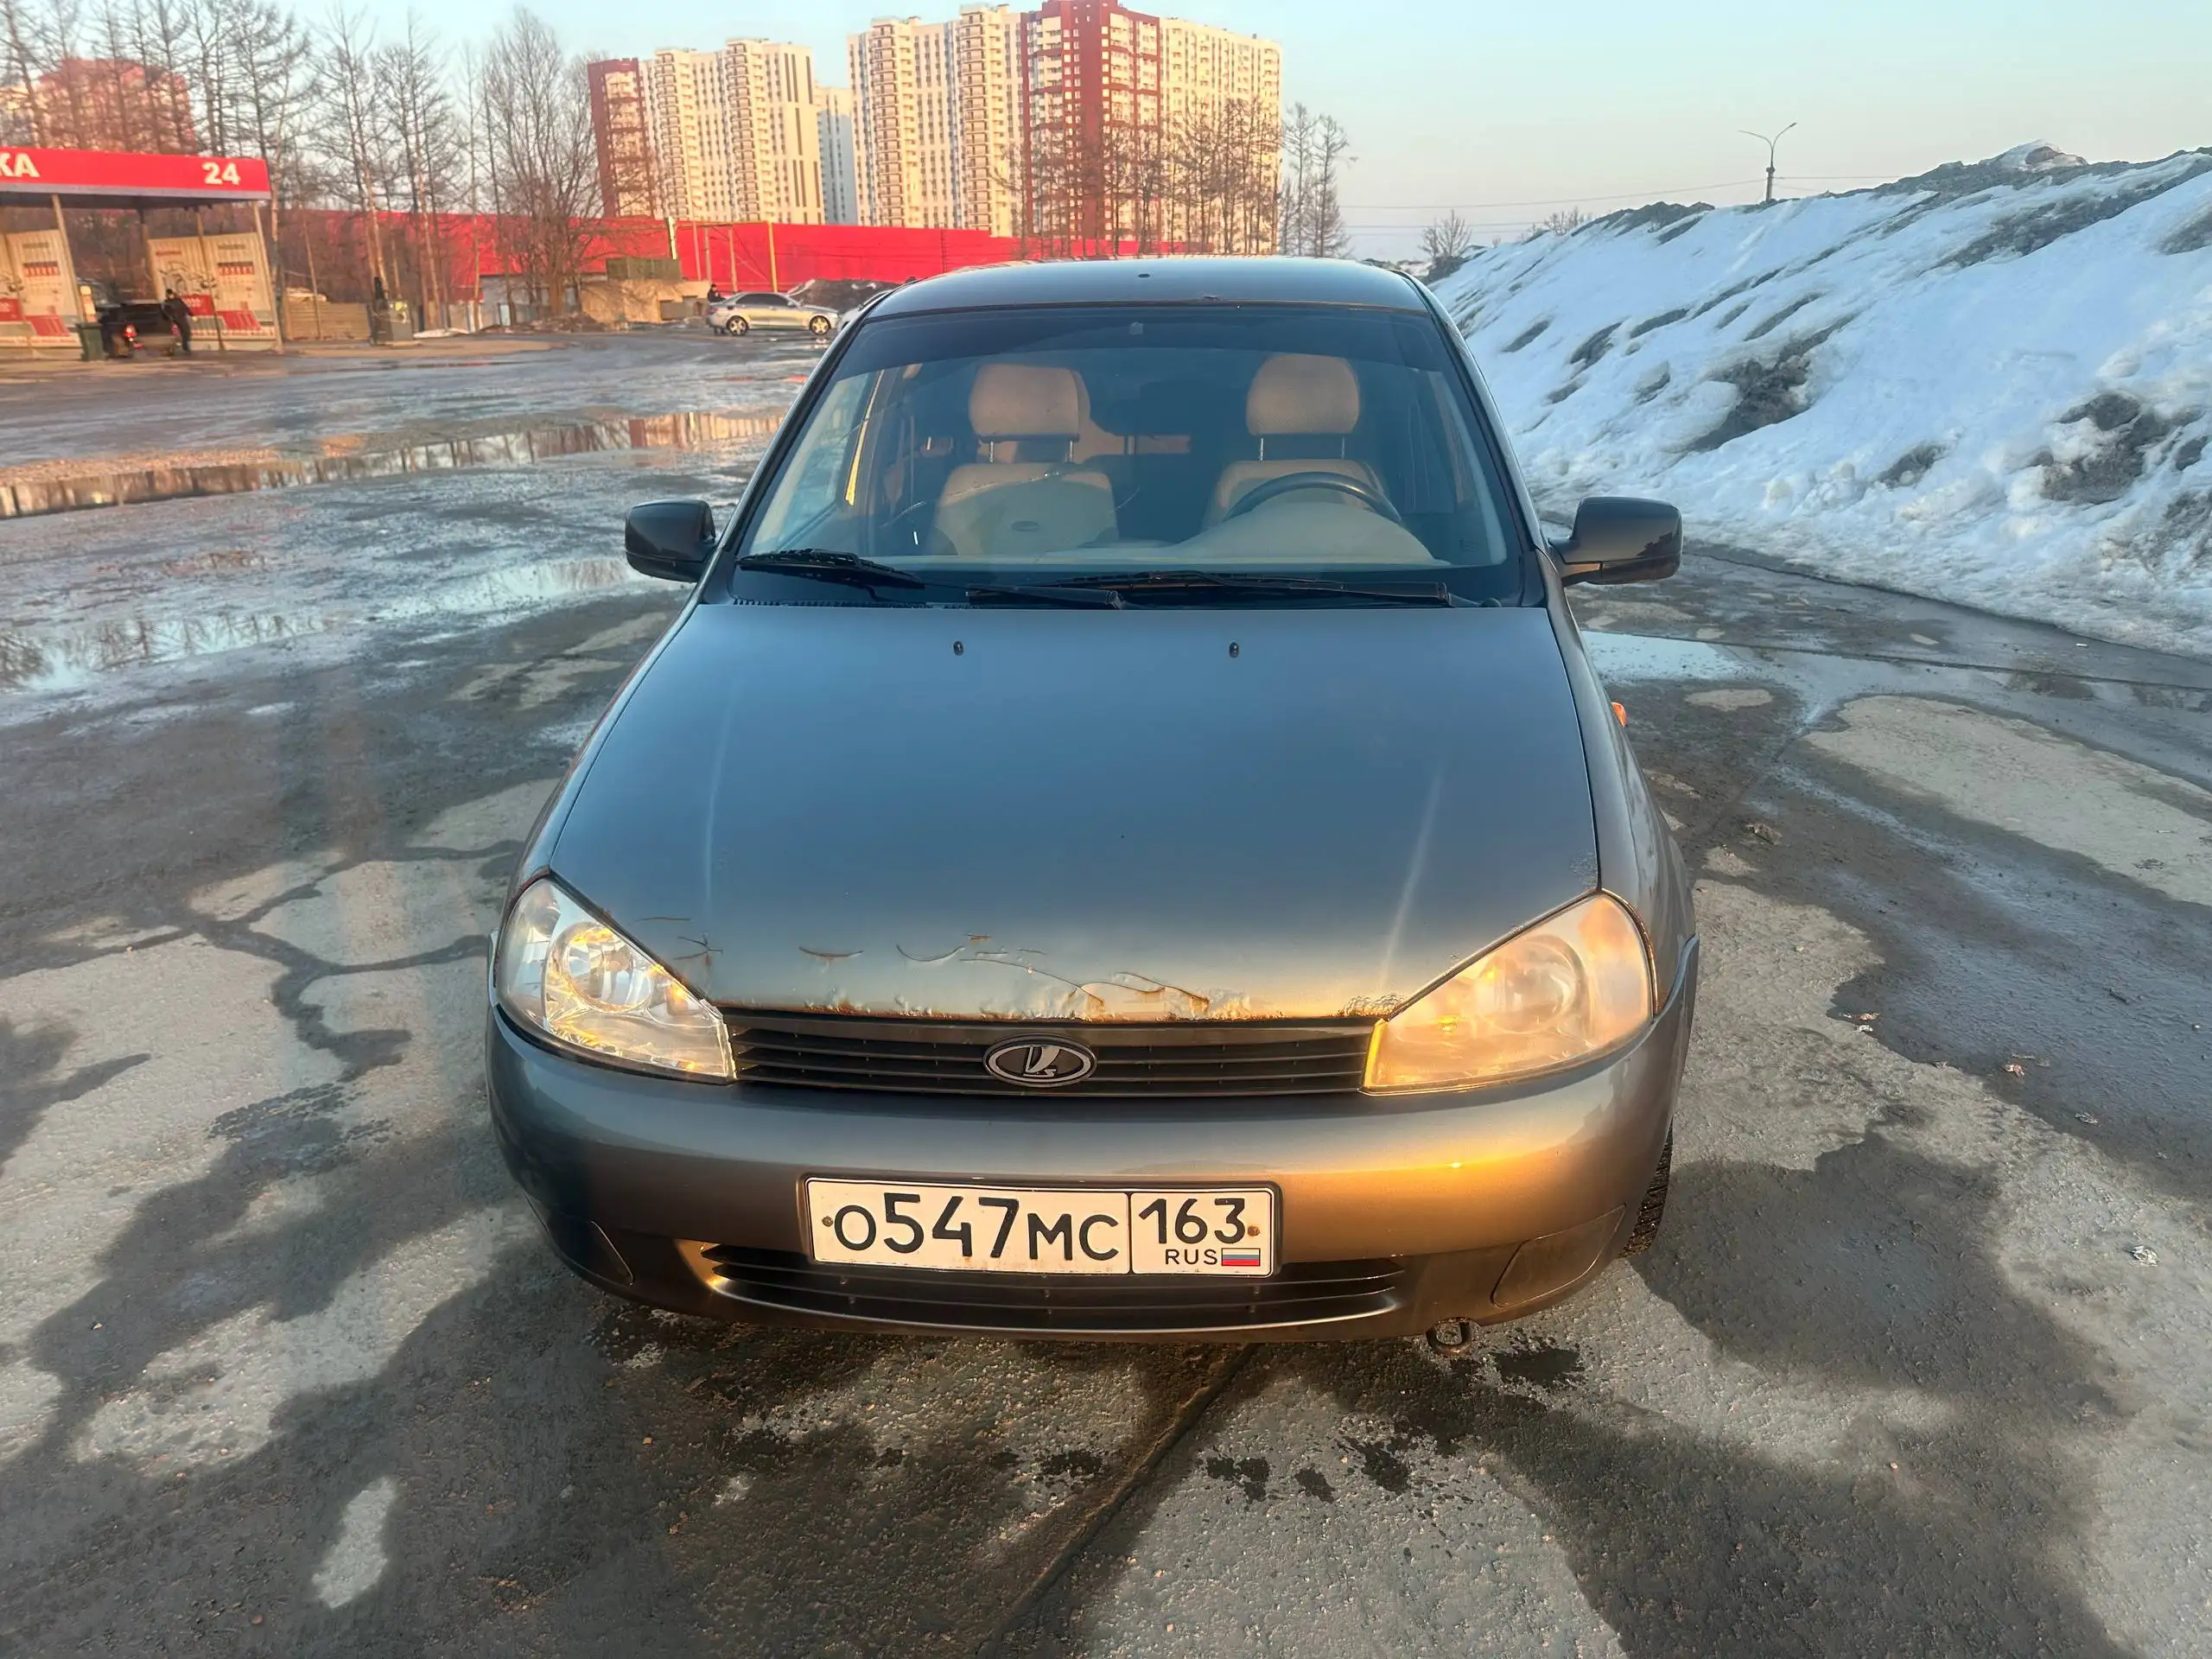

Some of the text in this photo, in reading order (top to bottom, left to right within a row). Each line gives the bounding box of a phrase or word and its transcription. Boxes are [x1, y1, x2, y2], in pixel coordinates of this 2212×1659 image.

[202, 162, 241, 185] 24
[1138, 1198, 1246, 1245] 163
[1164, 1248, 1218, 1267] RUS
